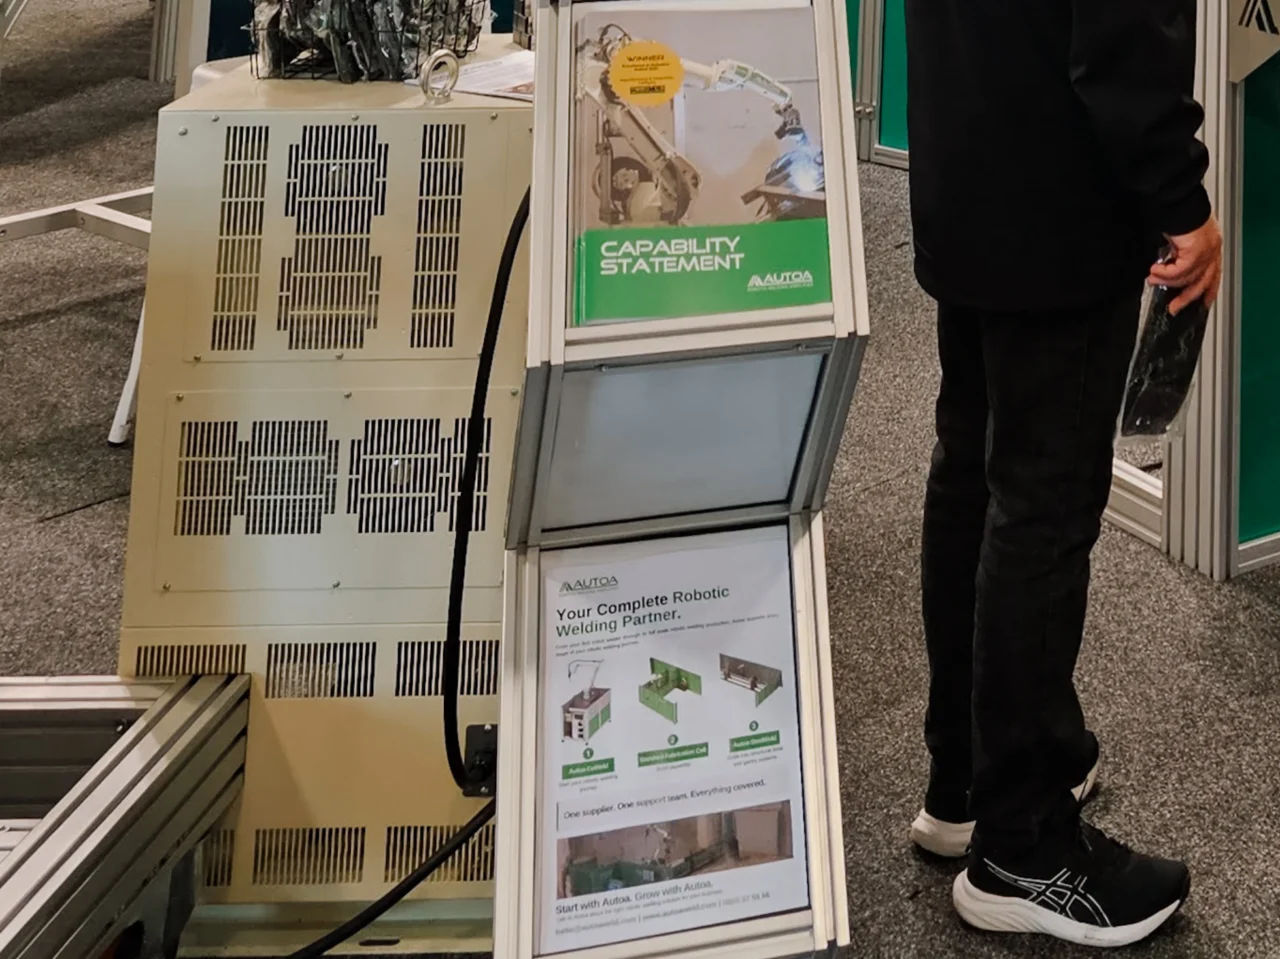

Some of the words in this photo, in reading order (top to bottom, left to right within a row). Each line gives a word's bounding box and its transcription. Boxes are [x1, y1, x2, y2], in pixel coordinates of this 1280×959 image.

[600, 236, 741, 257] CAPABILITY
[600, 253, 745, 275] STATEMENT
[764, 270, 813, 285] AUTOA
[573, 576, 619, 590] AUTOA
[556, 606, 593, 621] Your
[596, 593, 669, 617] Complete
[673, 586, 730, 603] Robotic
[556, 618, 618, 638] Welding
[622, 609, 682, 628] Partner.
[564, 811, 581, 820] One
[582, 805, 616, 817] supplier.
[617, 801, 635, 811] One
[636, 796, 666, 808] support
[690, 785, 732, 799] Everything
[733, 779, 766, 792] covered.
[556, 903, 578, 915] Start
[580, 900, 600, 911] with
[602, 895, 633, 907] Autoa.
[634, 890, 661, 902] Grow
[661, 885, 682, 896] with
[684, 880, 714, 892] Autoa.
